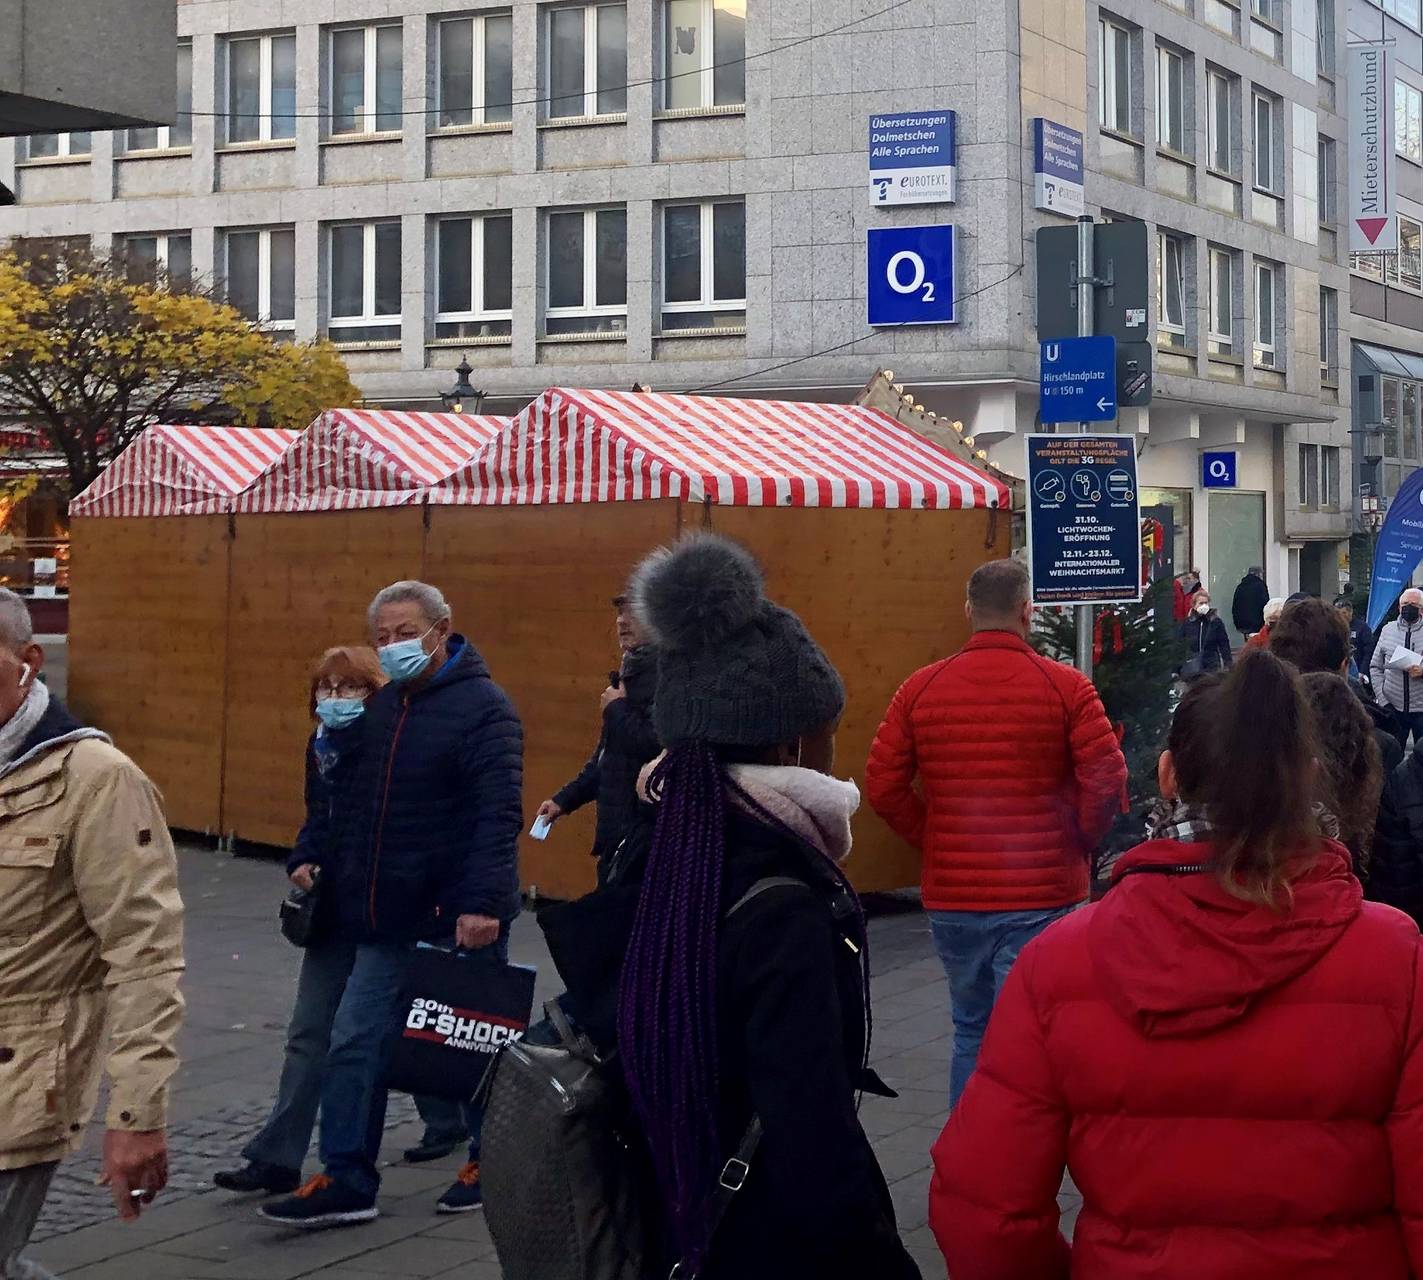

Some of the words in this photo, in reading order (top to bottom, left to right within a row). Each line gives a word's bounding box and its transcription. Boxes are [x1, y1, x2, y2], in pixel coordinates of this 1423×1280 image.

[872, 117, 946, 128] Übersetzungen
[872, 131, 936, 143] Dolmetschen
[1361, 51, 1379, 213] Mieterschutzbund
[872, 147, 892, 157] Alle
[894, 144, 940, 157] Sprachen
[886, 250, 936, 302] O2
[1047, 344, 1059, 362] U
[1043, 371, 1106, 382] Hirschlandplatz
[1060, 386, 1074, 395] 150
[1035, 449, 1128, 457] VERANSTALTUNGSFLÄCHE
[1081, 456, 1095, 464] 3G
[1209, 460, 1230, 481] O2
[1063, 534, 1110, 542] ERÖFFNUNG
[1400, 541, 1423, 551] Service
[1062, 550, 1113, 558] 12.11.-23.12.
[1049, 568, 1125, 576] WEIHNACHTSMARKT
[411, 998, 454, 1015] 30th
[406, 1008, 524, 1046] G-SHOCK
